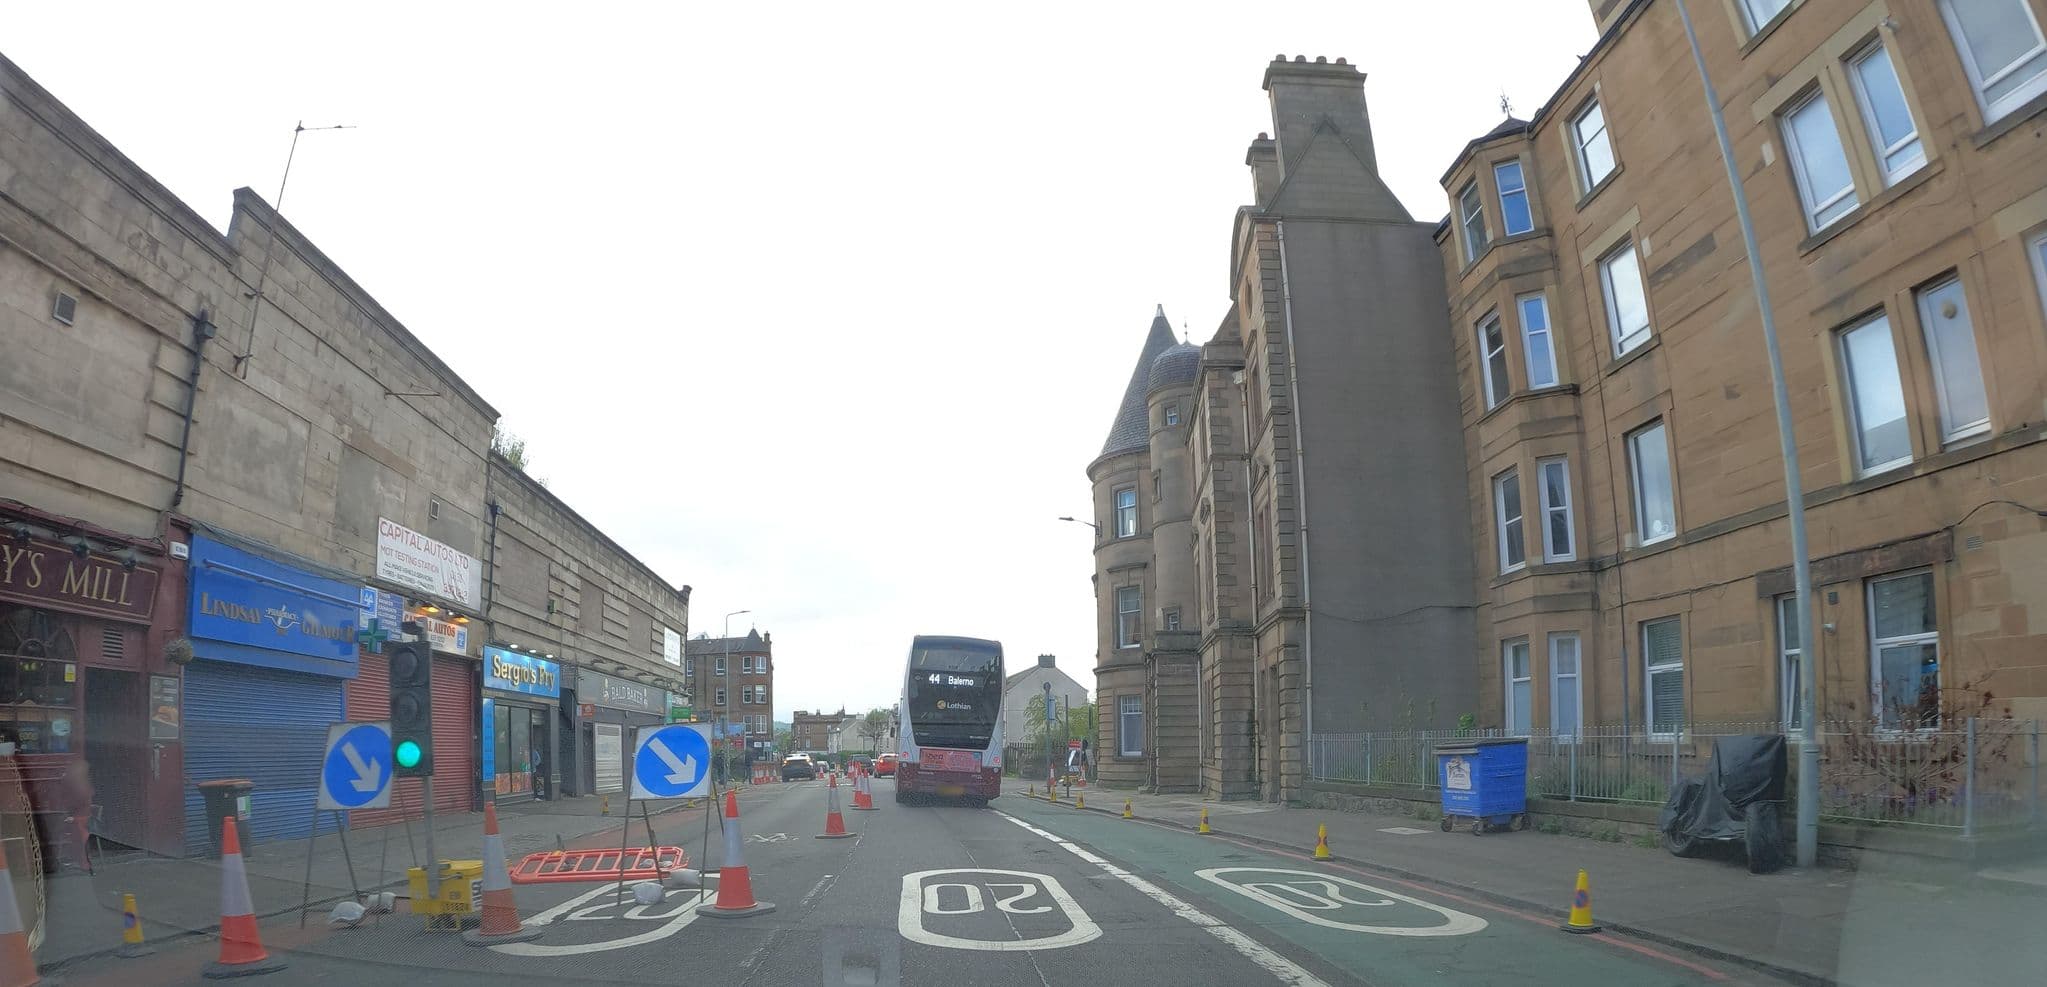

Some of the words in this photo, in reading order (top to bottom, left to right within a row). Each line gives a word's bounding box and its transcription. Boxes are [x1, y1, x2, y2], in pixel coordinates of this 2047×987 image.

[379, 520, 423, 551] CAPITAL
[424, 540, 454, 563] AUTOS
[454, 553, 469, 570] LTD
[380, 545, 394, 558] MOT
[395, 550, 418, 568] TESTING
[417, 558, 440, 574] STATION
[2, 544, 45, 588] Y'S
[60, 560, 133, 606] MILL
[200, 591, 262, 624] LINDSAY
[434, 621, 456, 638] AUTOS
[491, 653, 537, 688] Sergio's
[538, 665, 555, 690] Fry
[928, 673, 941, 685] 44
[948, 675, 974, 687] Balerno
[947, 701, 972, 711] Lothian
[923, 882, 1053, 915] 20
[1241, 881, 1397, 910] 20
